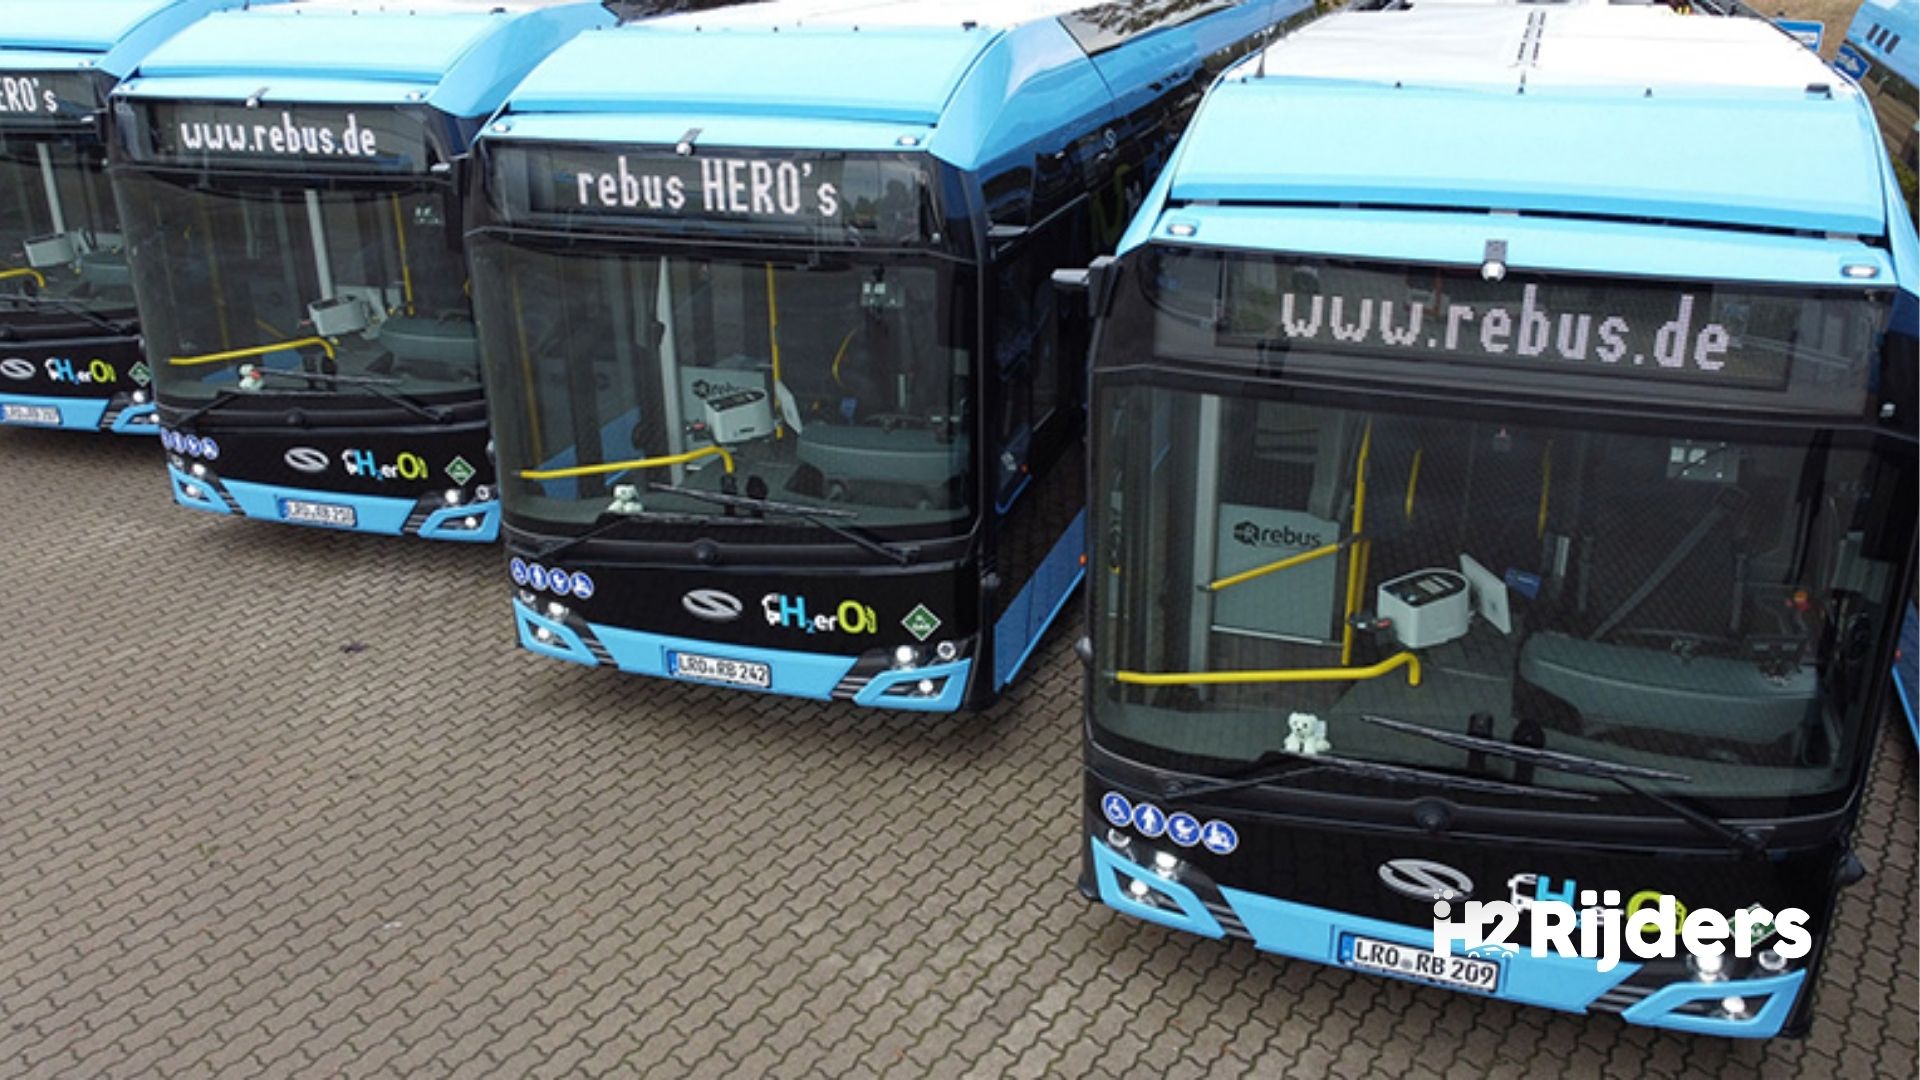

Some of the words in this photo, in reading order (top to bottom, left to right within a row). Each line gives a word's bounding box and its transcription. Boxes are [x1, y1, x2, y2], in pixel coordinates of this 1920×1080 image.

[181, 111, 377, 158] www.rebus.de
[577, 155, 685, 209] rebus
[700, 156, 839, 217] HERO's
[1280, 283, 1732, 371] www.rebus.de
[1260, 524, 1322, 547] rebus
[678, 654, 709, 674] LRO
[716, 659, 737, 678] RB
[738, 663, 769, 685] 242
[1355, 940, 1399, 967] LRO
[1415, 953, 1447, 976] RB
[1449, 959, 1494, 986] 209
